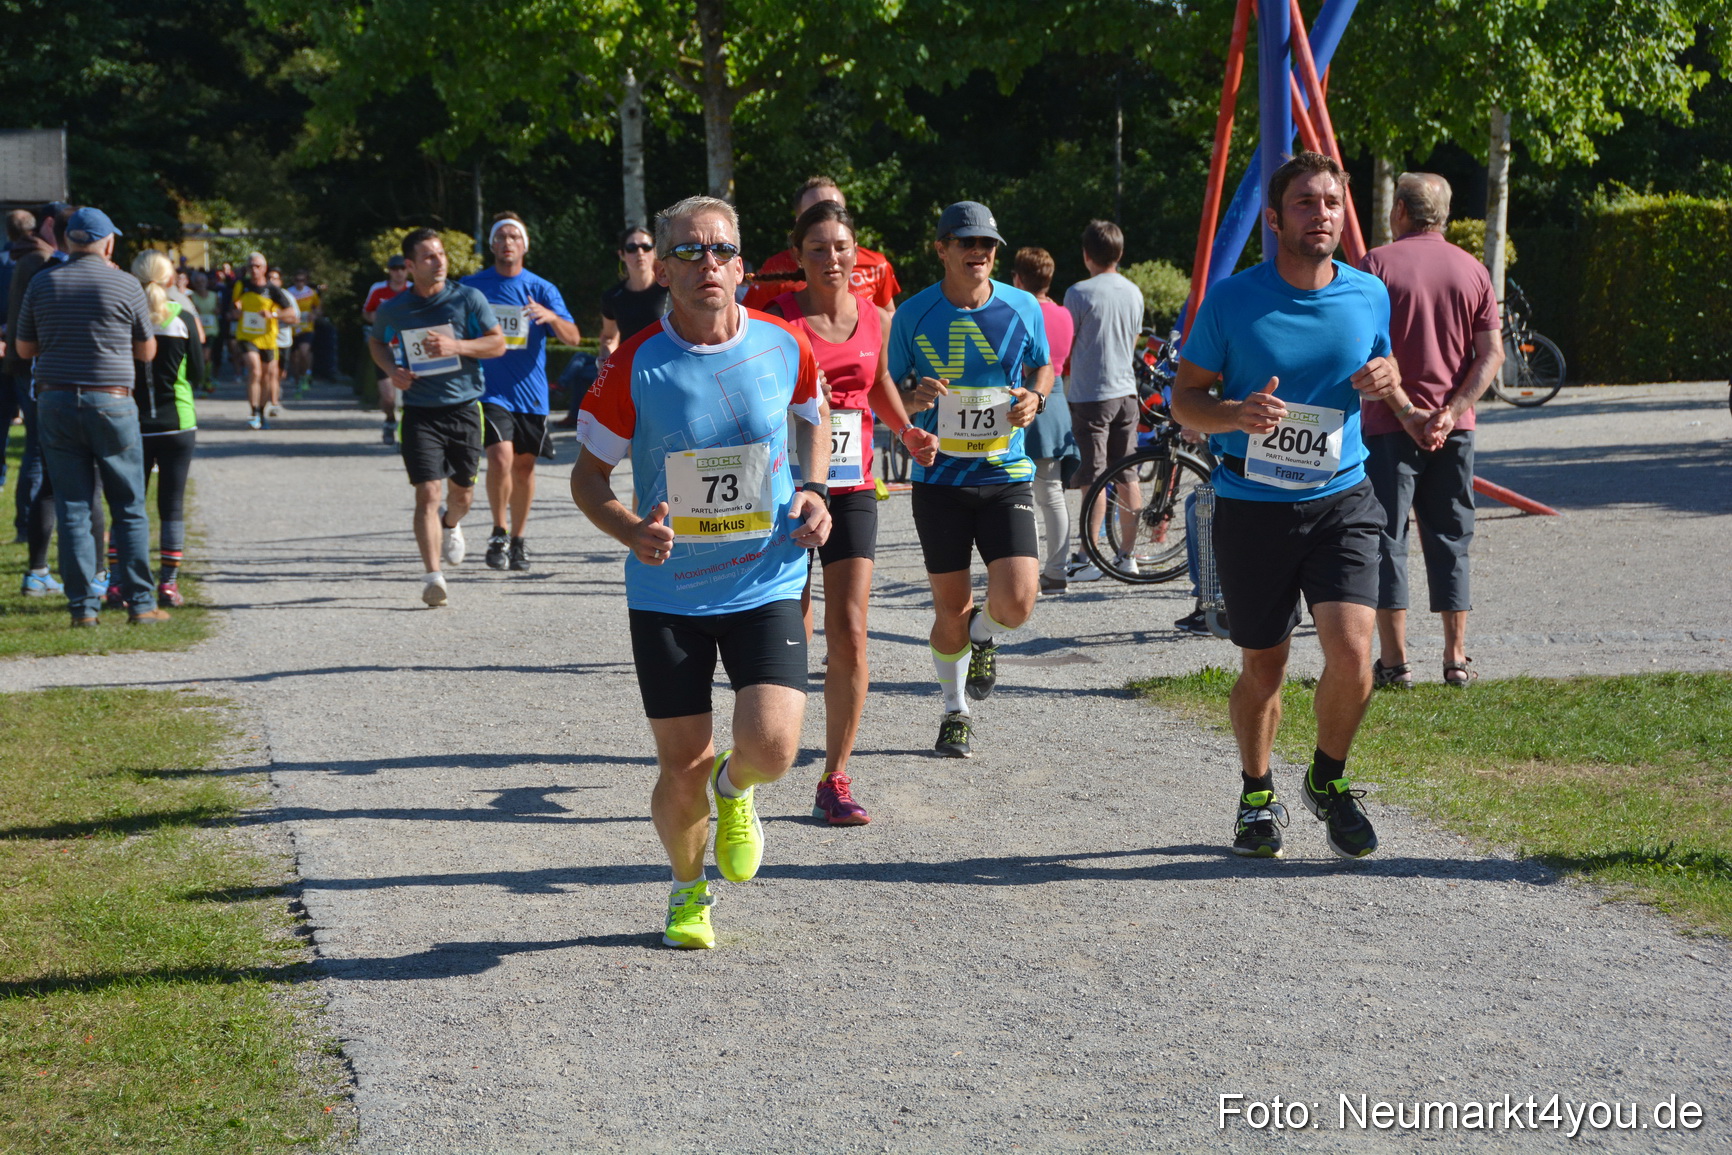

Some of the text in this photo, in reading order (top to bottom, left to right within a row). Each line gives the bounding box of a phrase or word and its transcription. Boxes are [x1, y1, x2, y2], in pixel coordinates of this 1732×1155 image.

[412, 342, 421, 356] 3
[961, 395, 991, 404] BOCK
[957, 408, 995, 430] 173
[967, 441, 985, 451] Petr
[1262, 425, 1328, 457] 2604
[696, 455, 742, 469] BOCK
[1265, 452, 1312, 465] PARTL Neumarkt
[827, 467, 836, 480] ja
[1275, 466, 1305, 481] Franz
[701, 474, 739, 504] 73
[713, 505, 743, 514] Neumarkt
[699, 519, 745, 532] Markus
